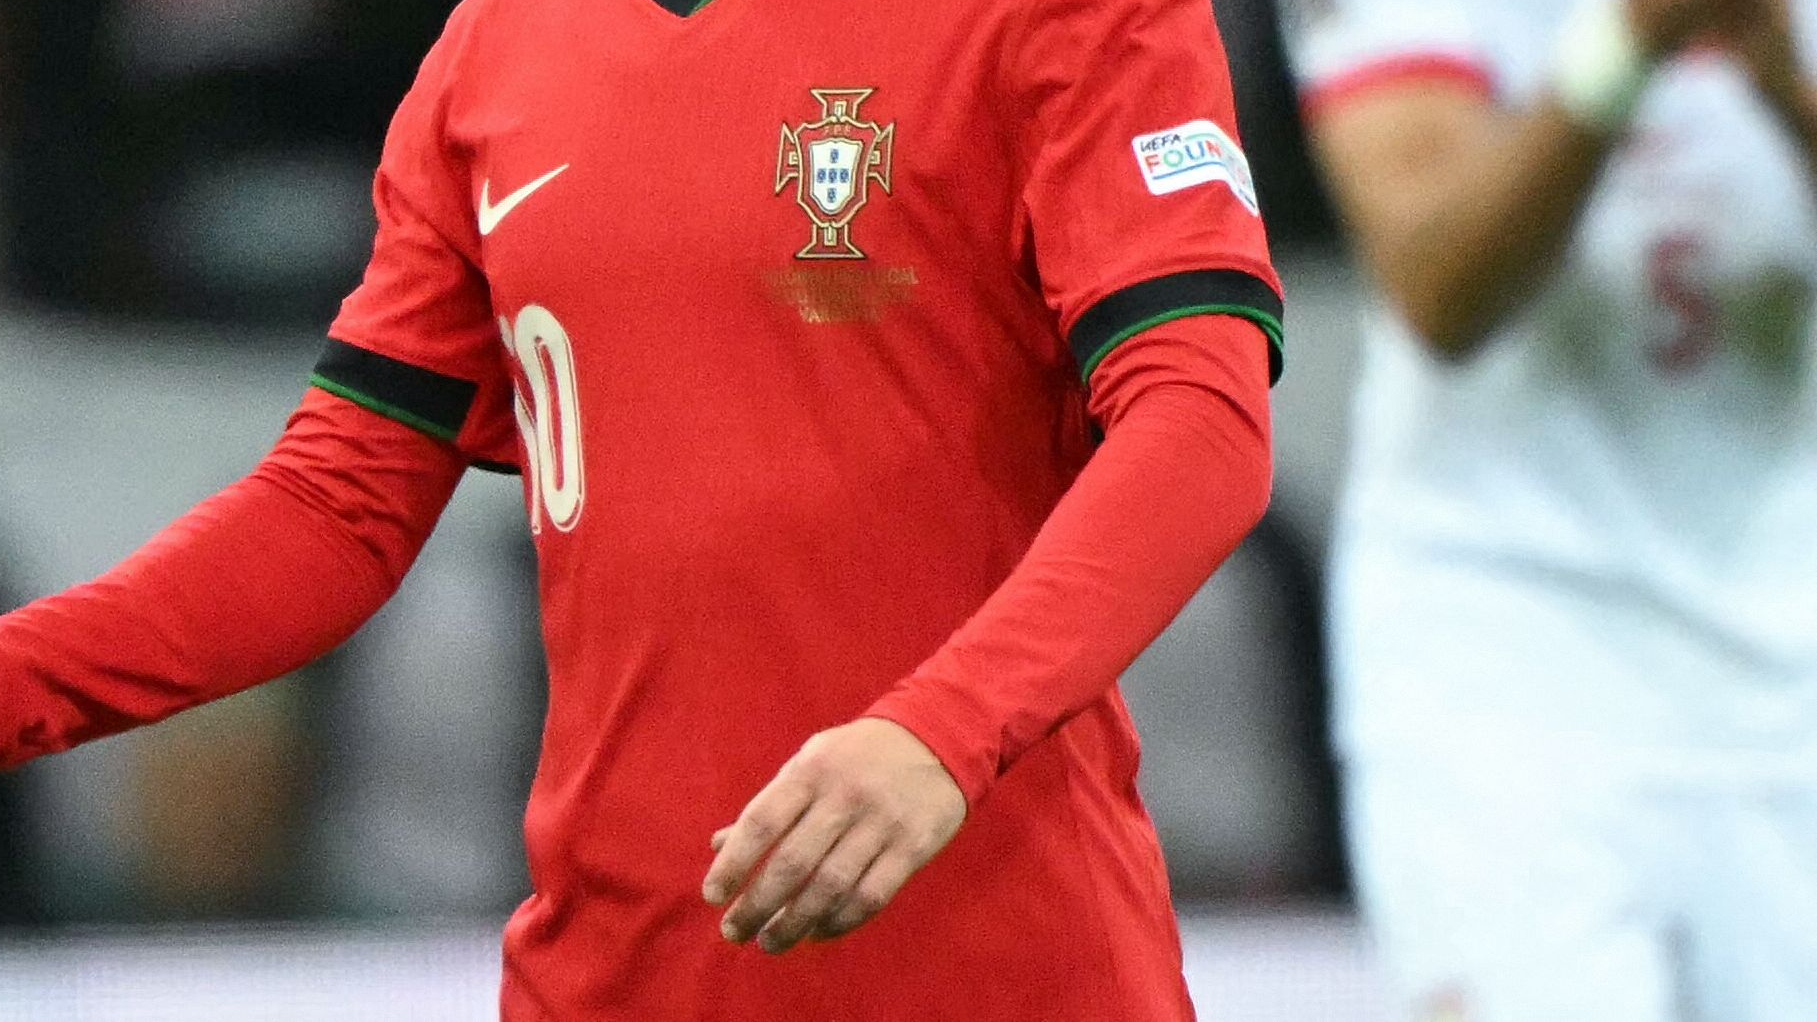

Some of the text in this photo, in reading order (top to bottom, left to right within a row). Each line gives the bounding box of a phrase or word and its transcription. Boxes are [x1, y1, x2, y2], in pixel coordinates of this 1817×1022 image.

[1140, 133, 1182, 153] UEFA
[1144, 139, 1224, 174] FOUN
[1644, 228, 1726, 378] 5
